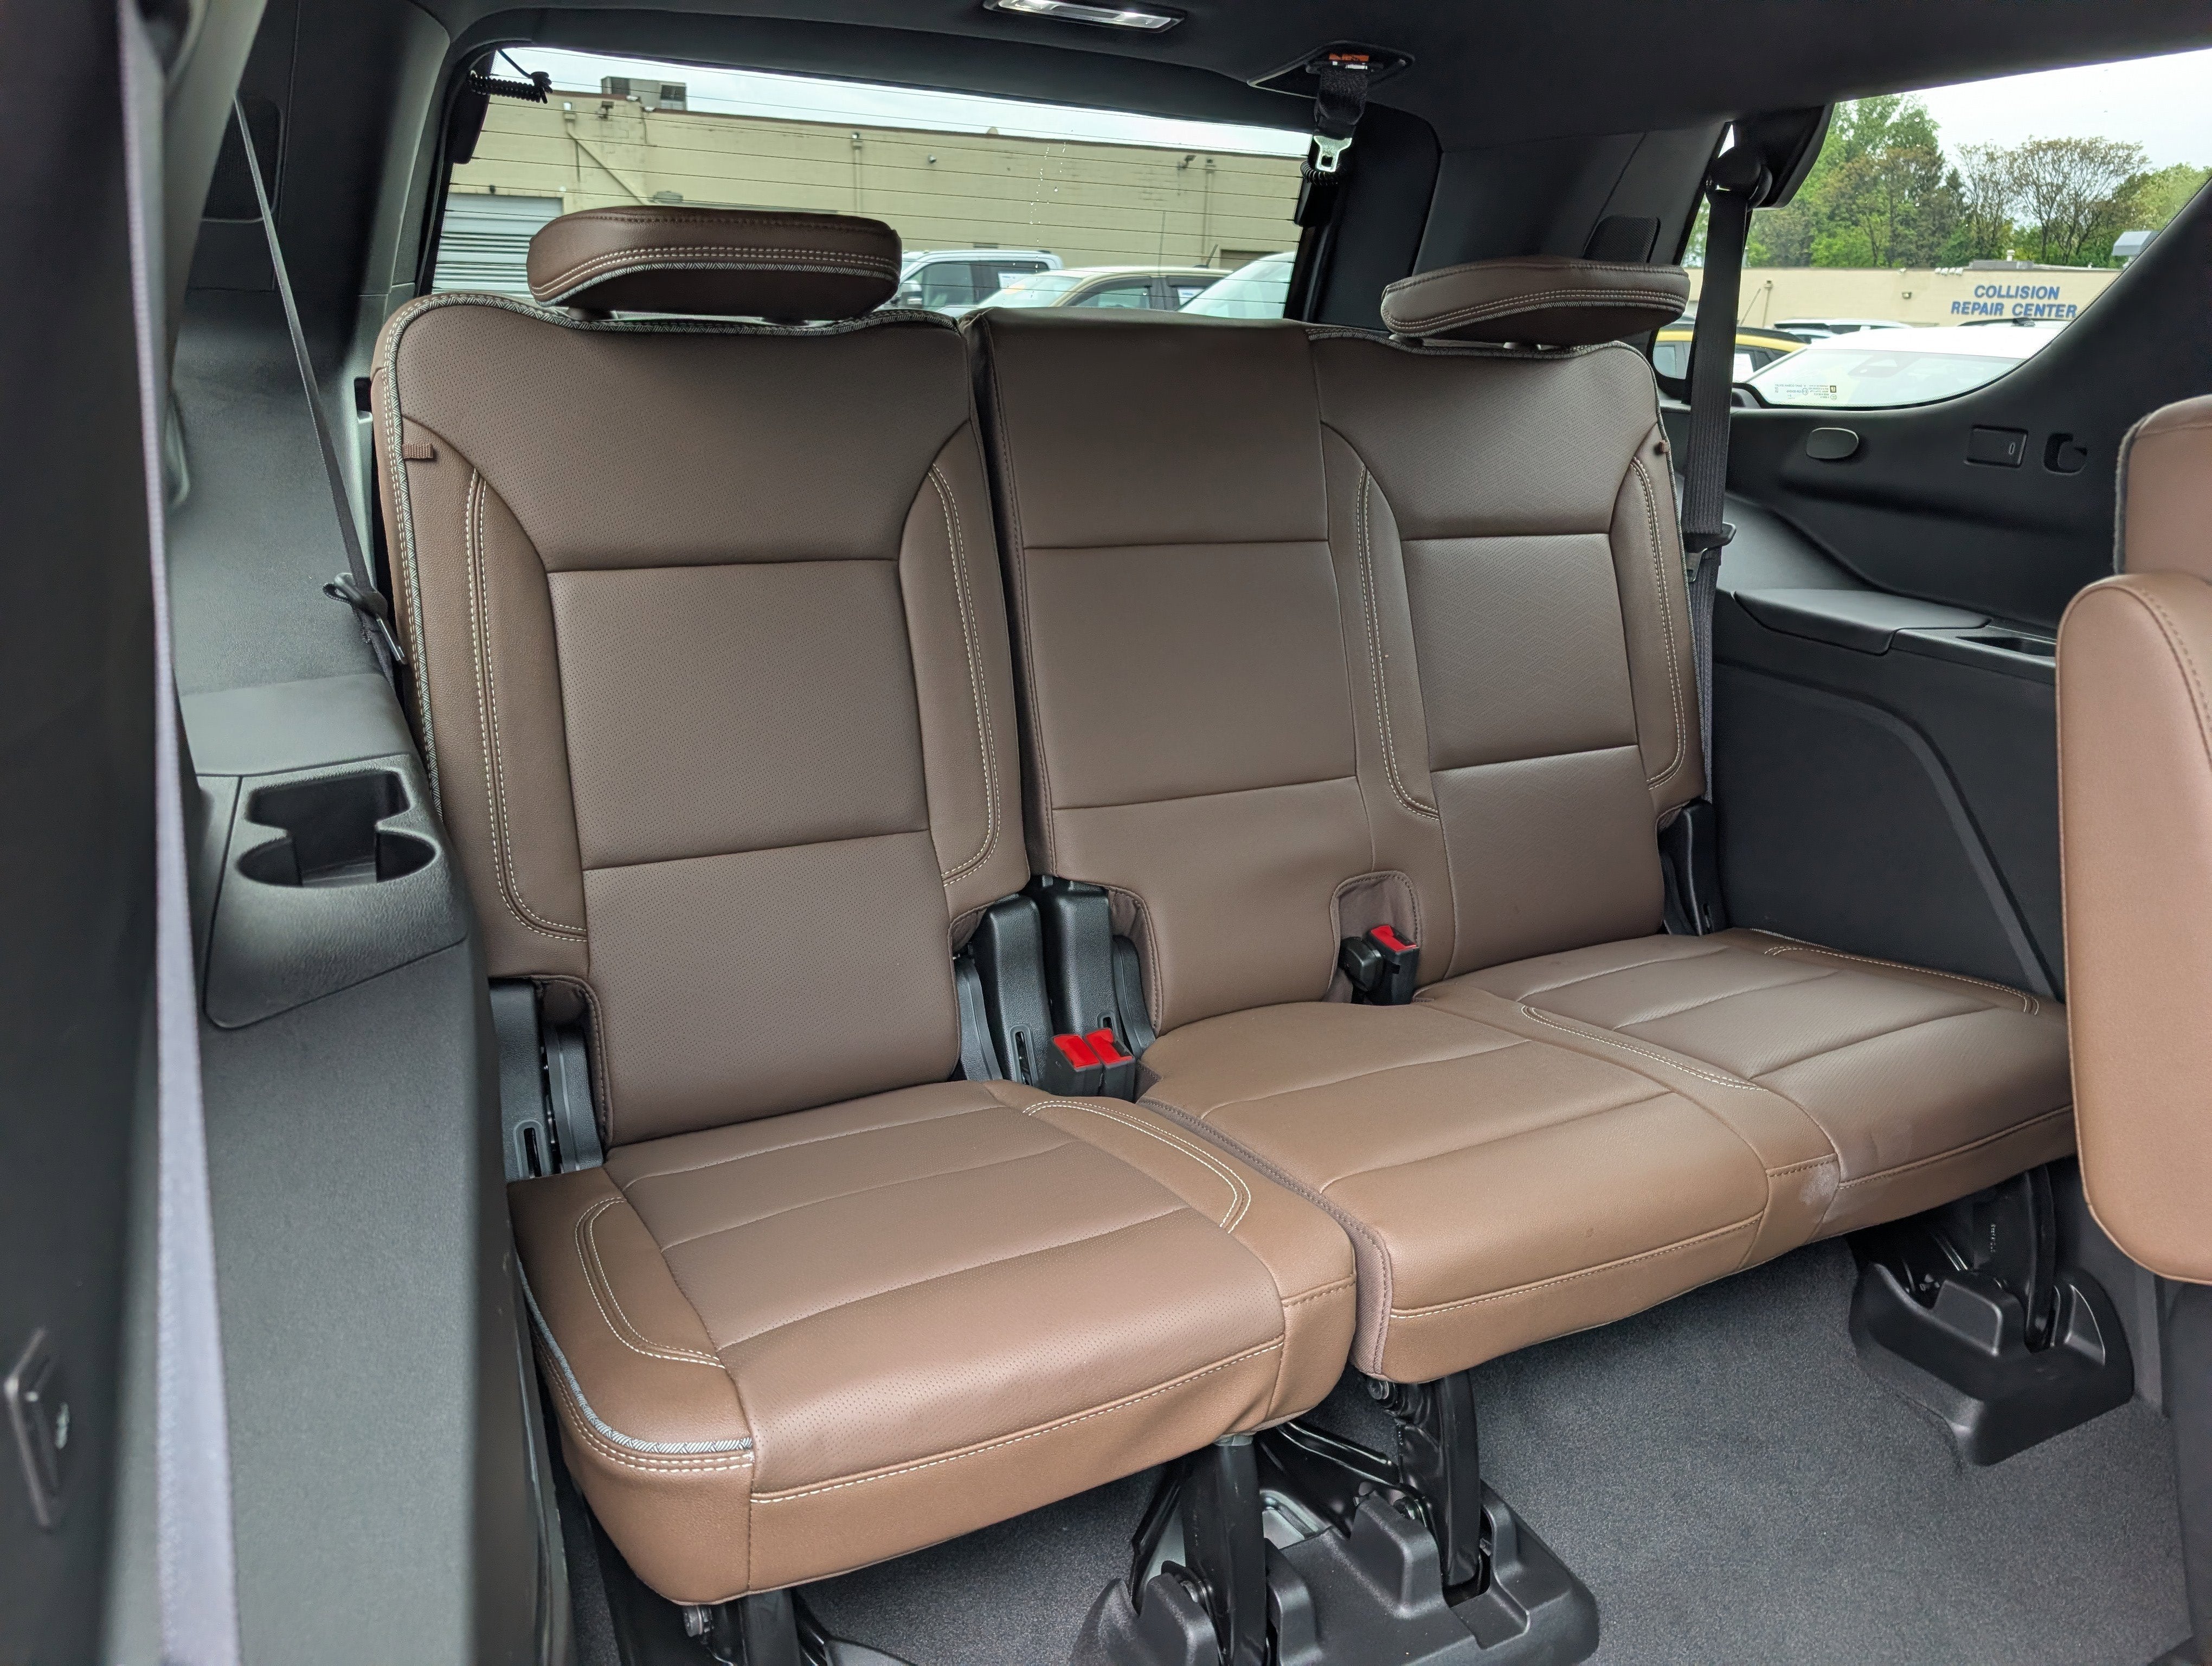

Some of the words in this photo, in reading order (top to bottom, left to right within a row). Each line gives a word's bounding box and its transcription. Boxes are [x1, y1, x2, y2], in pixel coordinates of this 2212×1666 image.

[1974, 285, 2060, 300] COLLISION
[1951, 301, 2004, 316] REPAIR
[2012, 303, 2078, 318] CENTER
